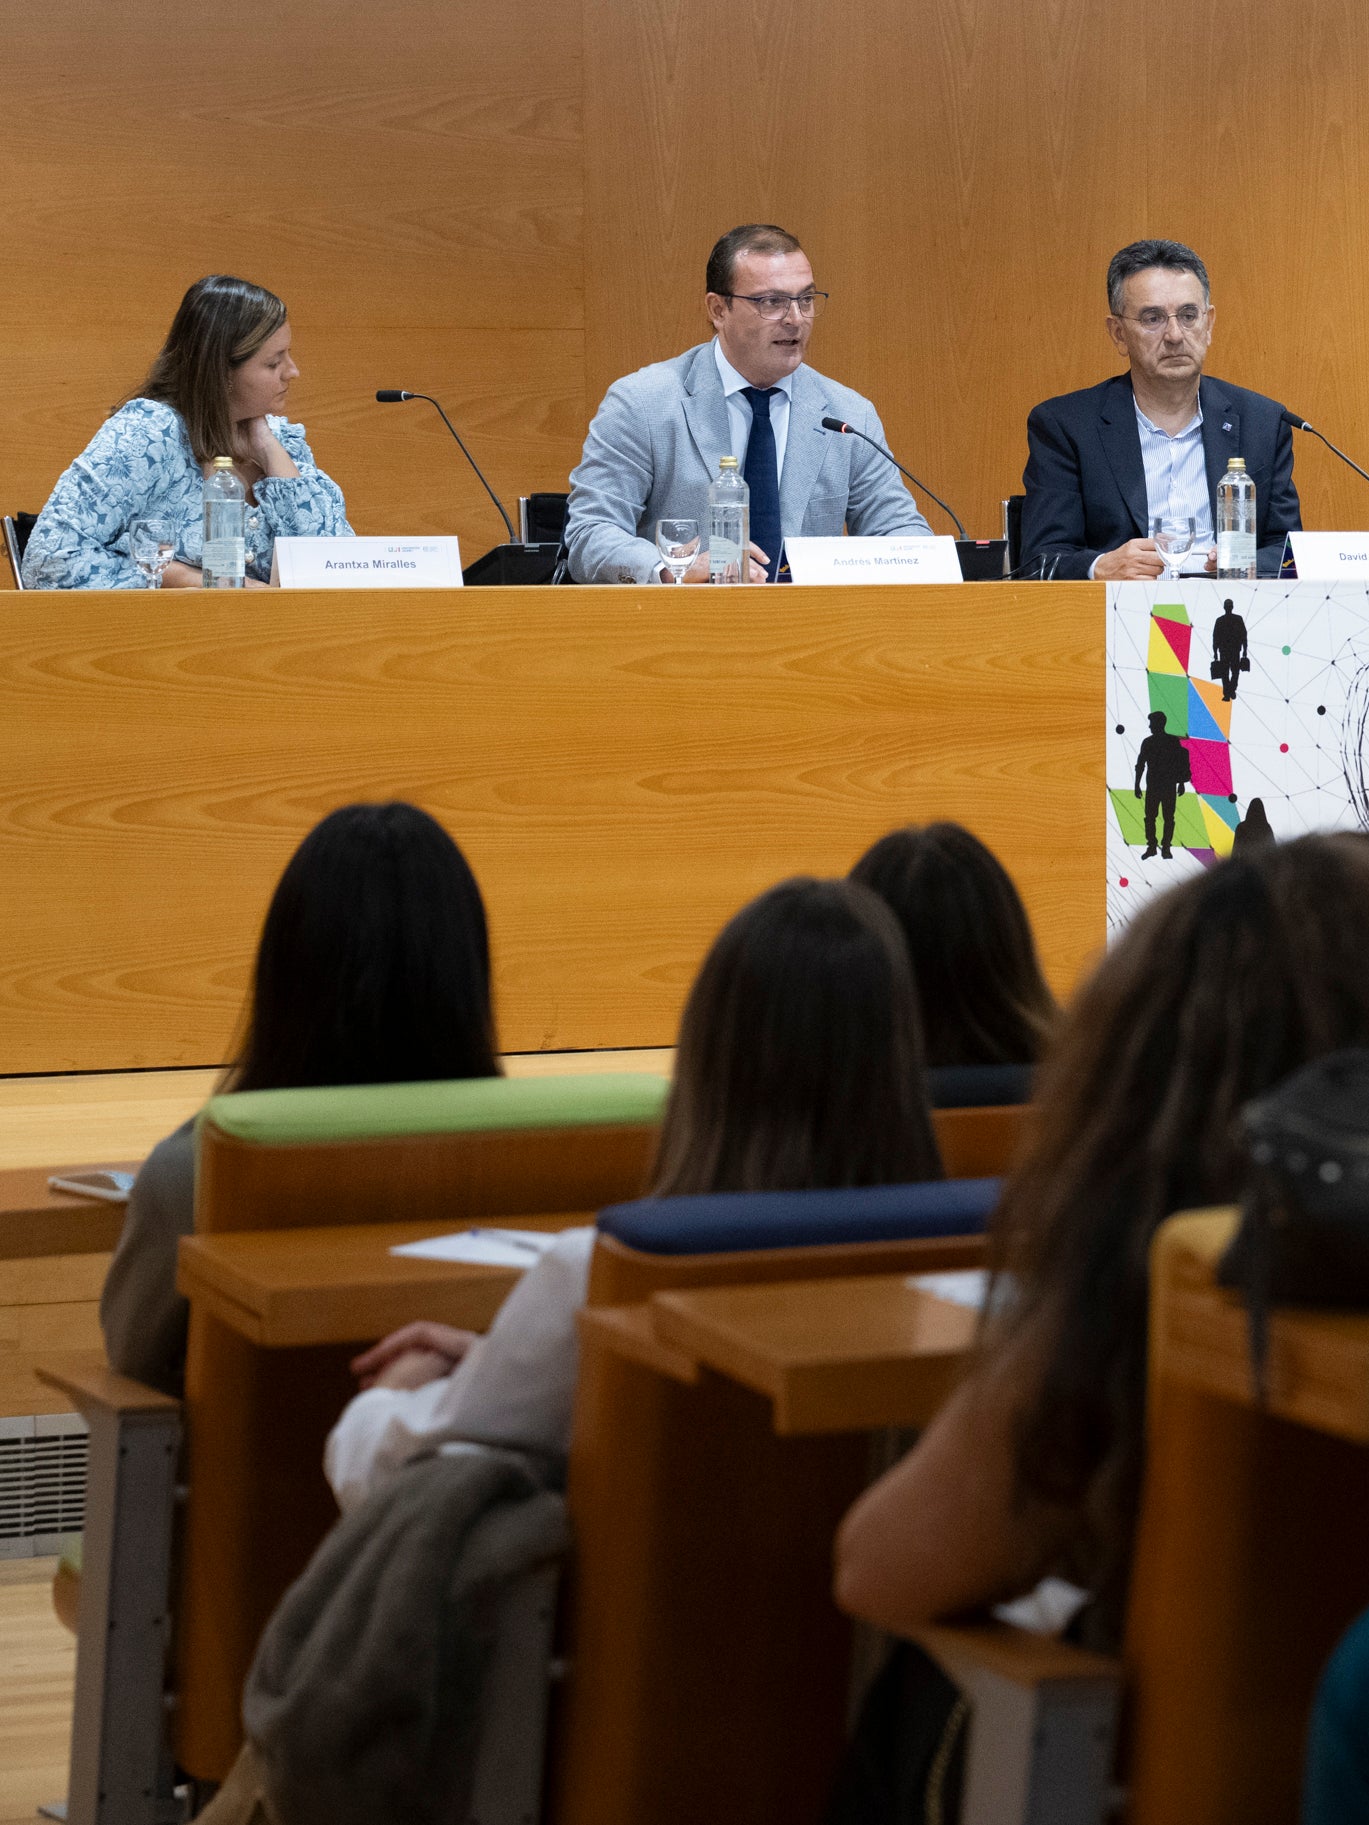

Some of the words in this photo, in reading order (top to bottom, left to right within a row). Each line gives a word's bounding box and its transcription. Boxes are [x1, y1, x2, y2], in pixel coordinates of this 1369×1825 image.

[1339, 552, 1368, 561] David
[325, 560, 369, 569] Arantxa
[372, 559, 417, 569] Miralles
[833, 557, 871, 566] Andrés
